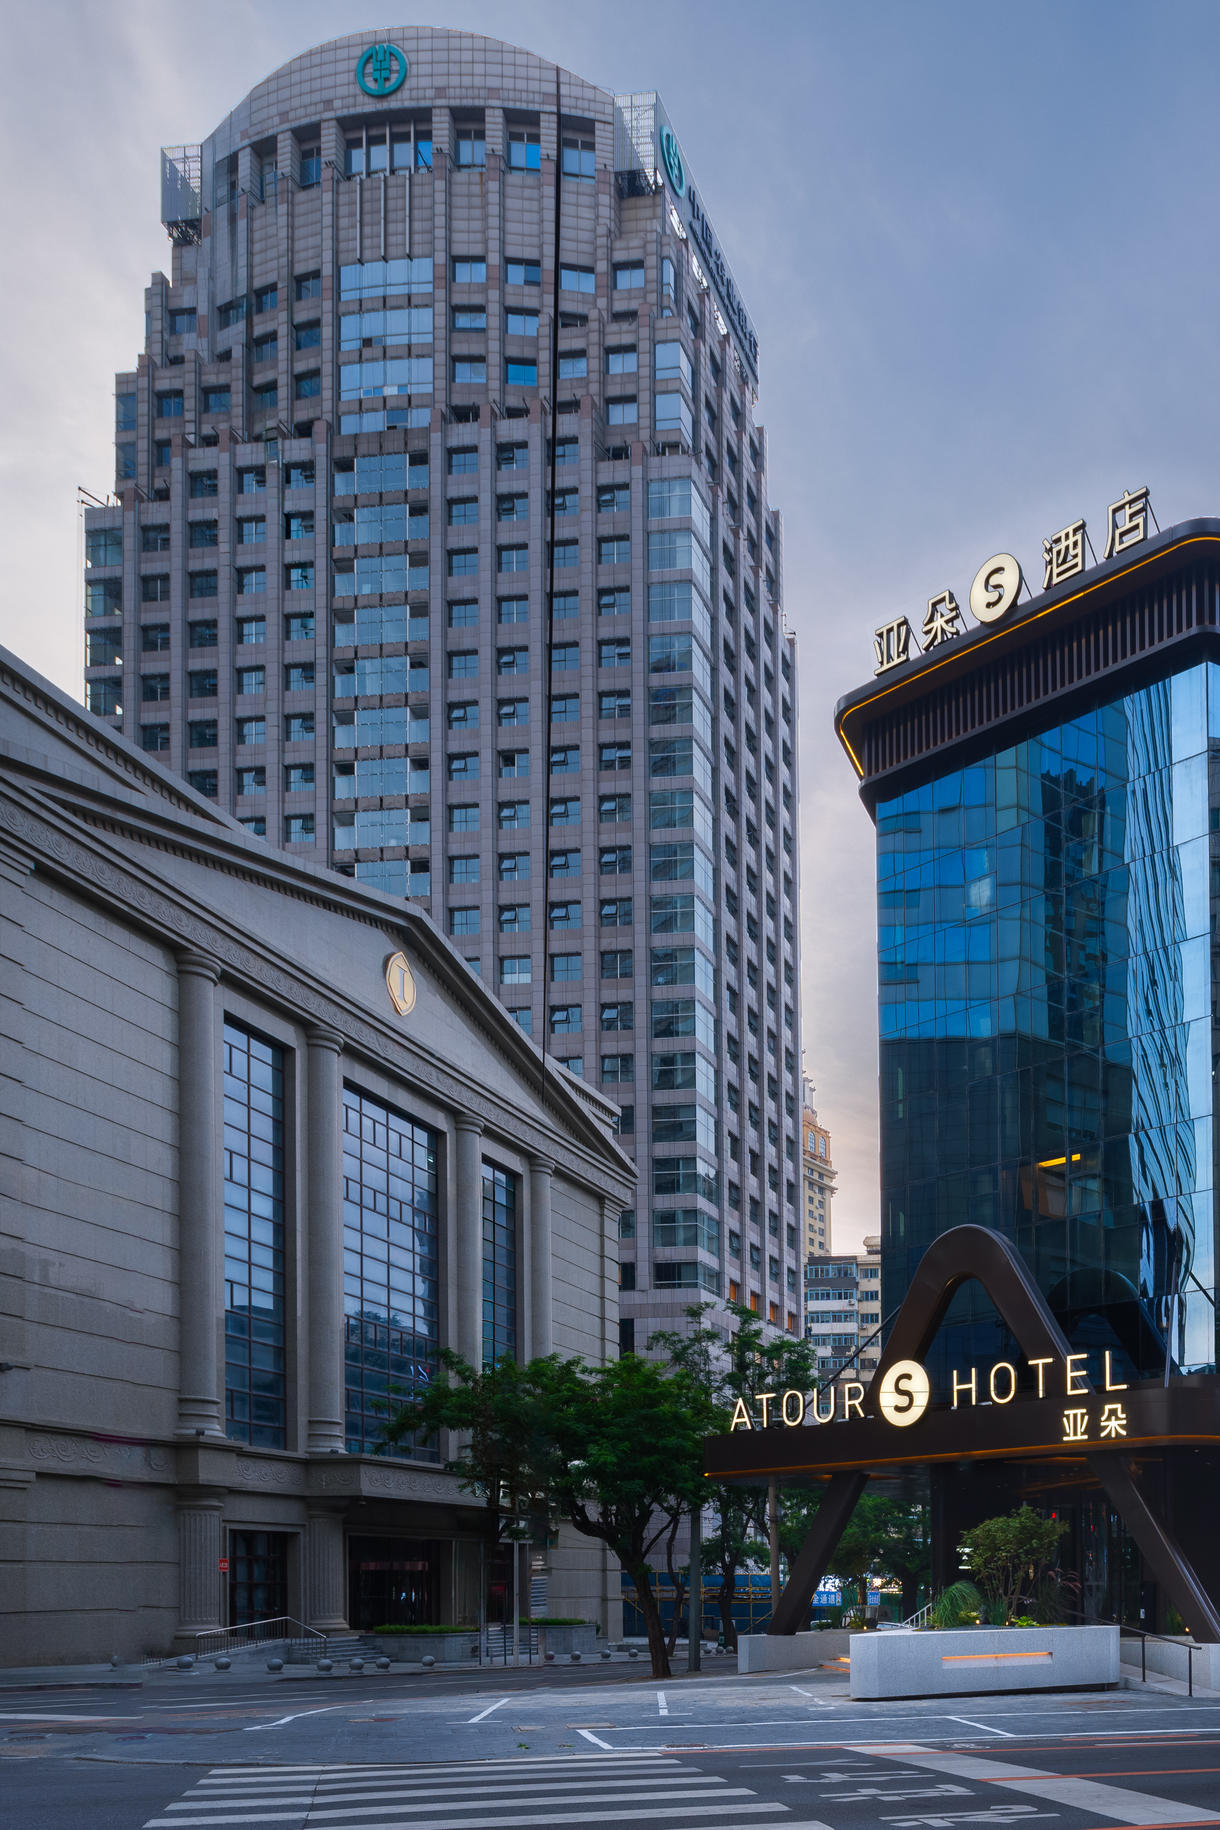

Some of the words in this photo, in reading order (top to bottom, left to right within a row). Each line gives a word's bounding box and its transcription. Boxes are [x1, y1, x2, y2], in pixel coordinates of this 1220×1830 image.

[873, 589, 960, 677] 亚朵
[1042, 486, 1151, 592] 酒店
[730, 1382, 866, 1432] ATOUR
[952, 1350, 1129, 1407] HOTEL
[1062, 1403, 1129, 1441] 亚朵
